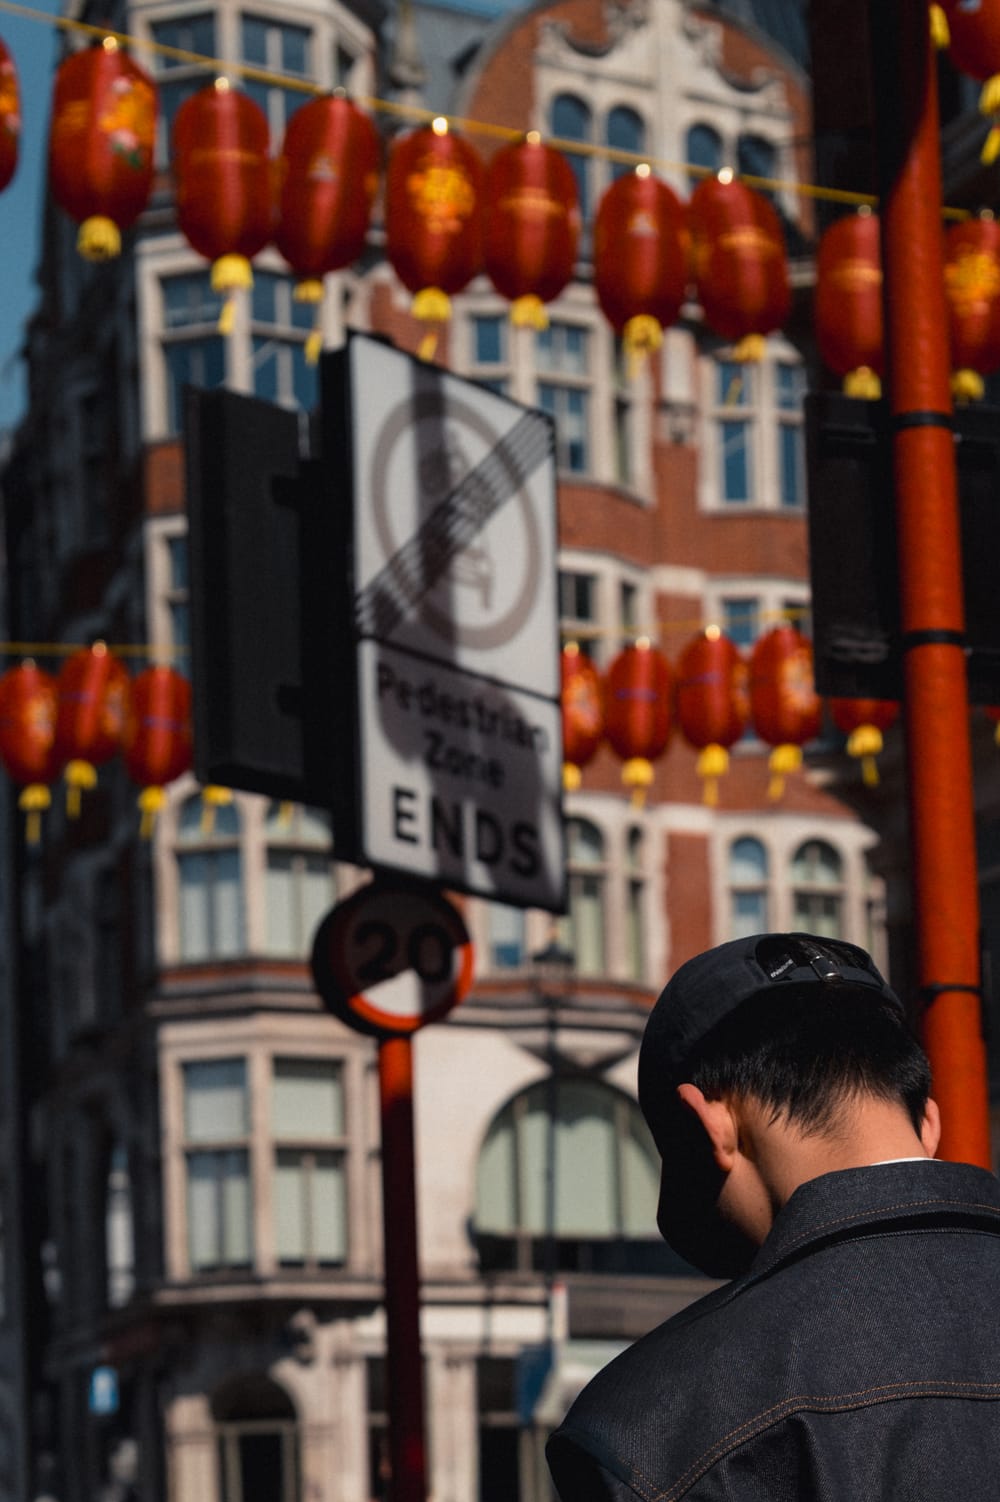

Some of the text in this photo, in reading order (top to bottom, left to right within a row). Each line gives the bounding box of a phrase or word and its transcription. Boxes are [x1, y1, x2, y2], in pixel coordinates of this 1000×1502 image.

[378, 662, 547, 752] Pedestrian
[425, 730, 505, 788] Zone
[394, 784, 539, 878] ENDS
[355, 920, 452, 982] 20
